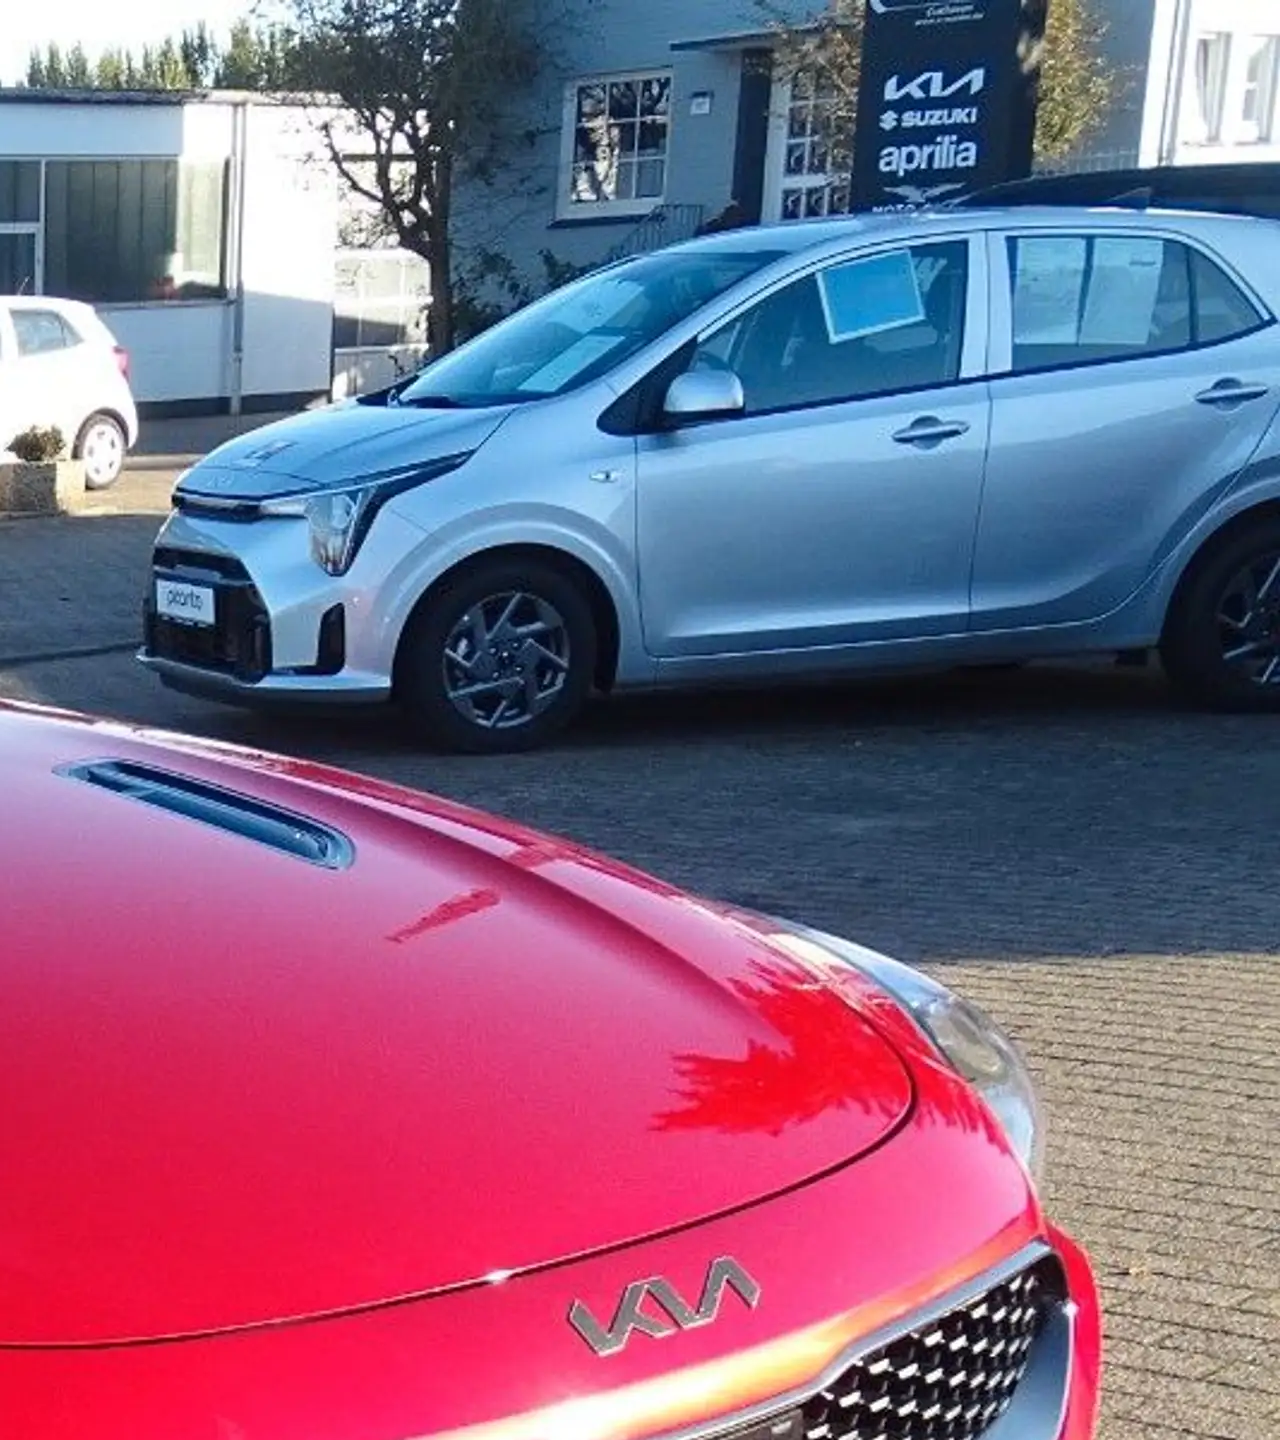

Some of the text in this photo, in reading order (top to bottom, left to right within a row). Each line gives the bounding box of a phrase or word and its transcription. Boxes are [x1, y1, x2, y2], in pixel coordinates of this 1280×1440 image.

[883, 67, 985, 101] KIA
[901, 107, 978, 128] SUZUKI
[878, 134, 977, 177] aprilia
[568, 1256, 762, 1357] KIA
